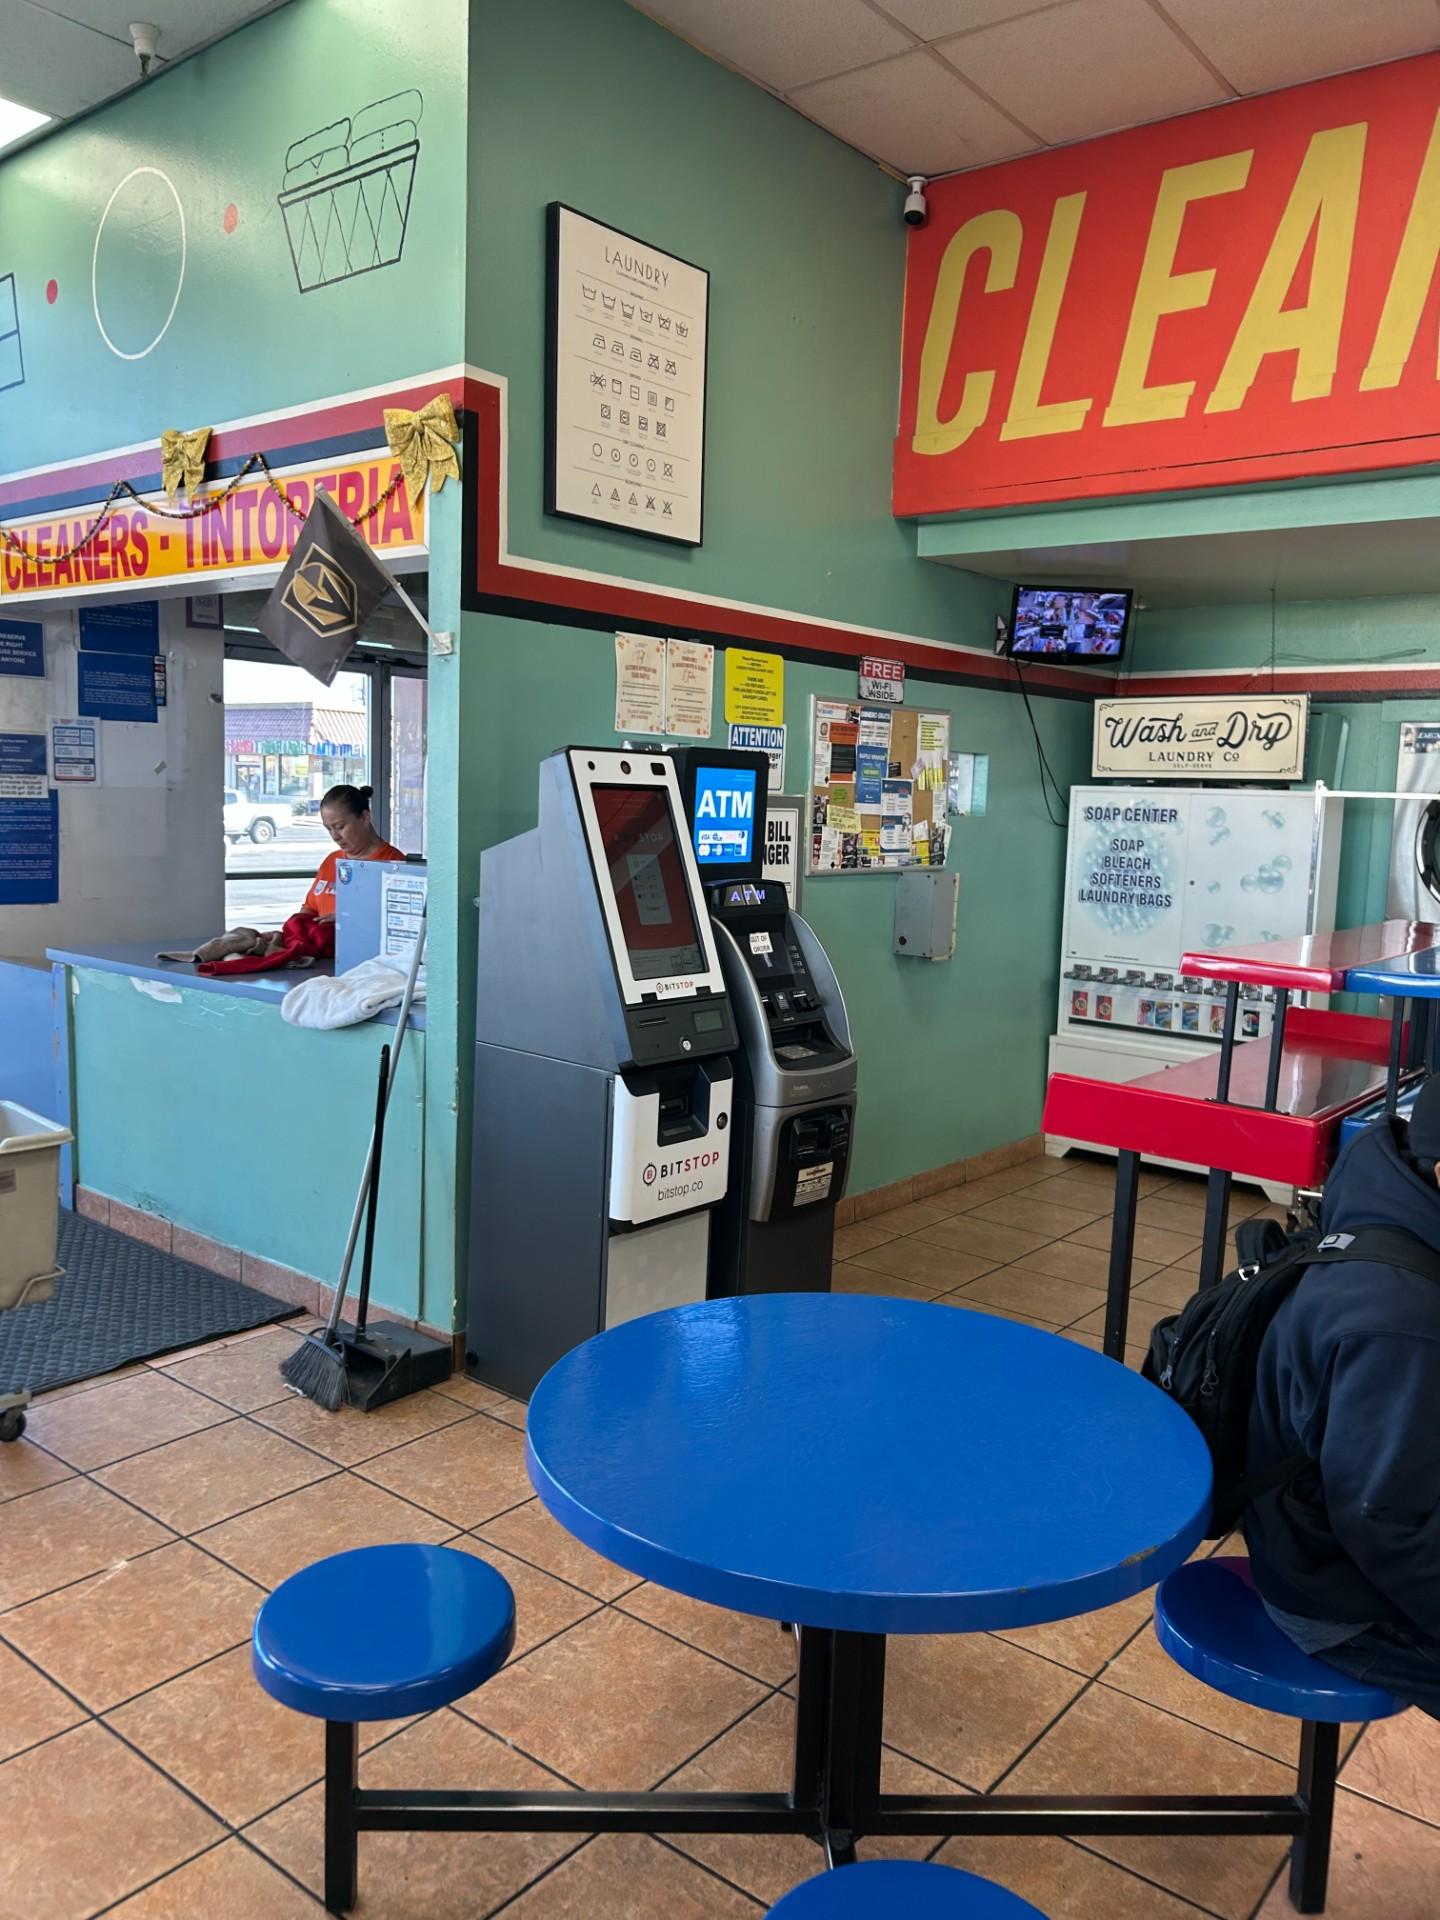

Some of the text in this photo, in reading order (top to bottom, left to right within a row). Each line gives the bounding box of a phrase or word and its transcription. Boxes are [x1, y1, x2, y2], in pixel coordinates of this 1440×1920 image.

[605, 246, 669, 288] LAUNDRY
[5, 510, 149, 590] CLEANERS
[184, 463, 414, 569] TINTORRIA
[863, 660, 902, 681] FREE
[732, 726, 784, 748] ATTENTION
[1105, 711, 1292, 750] Wash and Dry
[1148, 751, 1215, 763] LAUNDRY
[697, 789, 752, 818] ATM
[1085, 806, 1178, 824] SOAP CENTER
[768, 821, 791, 841] BILL
[1111, 838, 1145, 853] SOAP
[1103, 855, 1151, 871] BLEACH
[1091, 872, 1162, 889] SOFTENERS
[731, 889, 766, 902] ATM
[1080, 888, 1172, 908] LAUNDRY BAGS
[664, 981, 694, 991] BITSTOP
[661, 1152, 720, 1178] BITSTOP
[658, 1181, 704, 1200] bitstop.co
